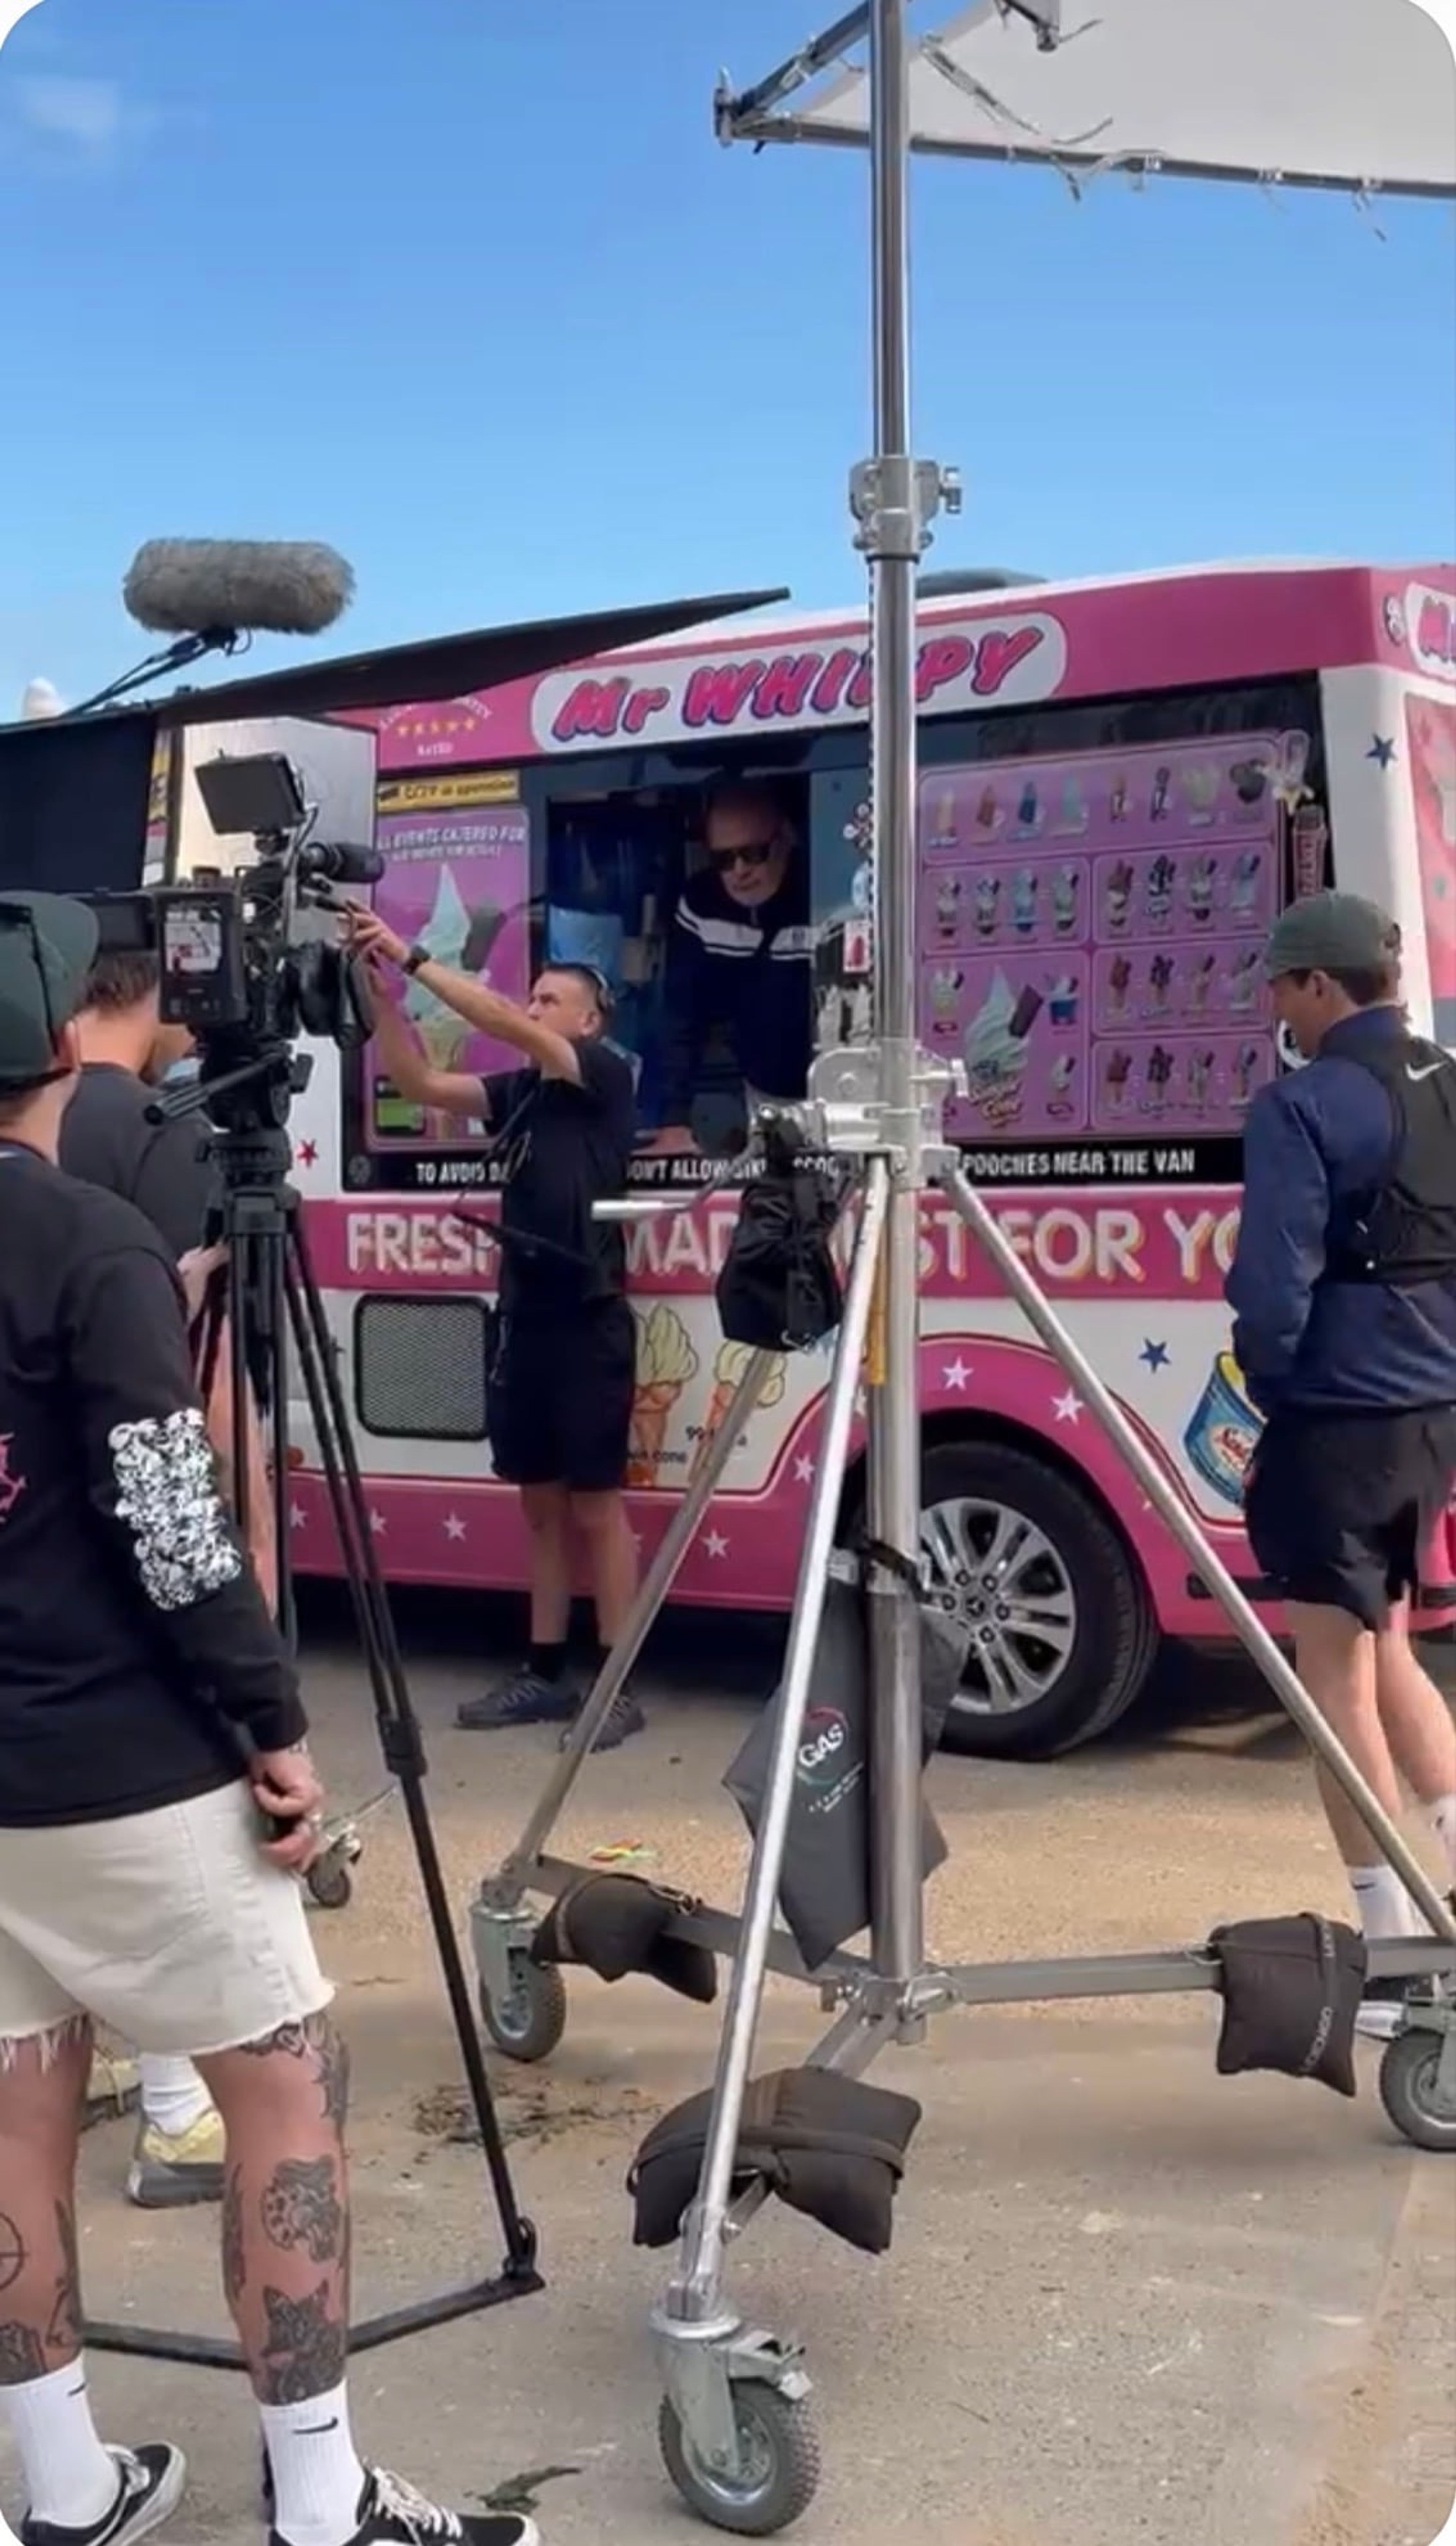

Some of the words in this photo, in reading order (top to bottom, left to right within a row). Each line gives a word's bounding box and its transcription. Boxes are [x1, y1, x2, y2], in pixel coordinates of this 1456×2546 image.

[552, 677, 670, 742] Mr
[416, 1162, 437, 1184] TO
[438, 1162, 485, 1184] AVOID
[962, 1152, 1050, 1176] POOCHES
[1054, 1151, 1104, 1175] NEAR
[1112, 1151, 1148, 1174] THE
[1153, 1148, 1195, 1173] VAN
[997, 1209, 1147, 1282] FOR
[799, 1723, 844, 1768] GAS
